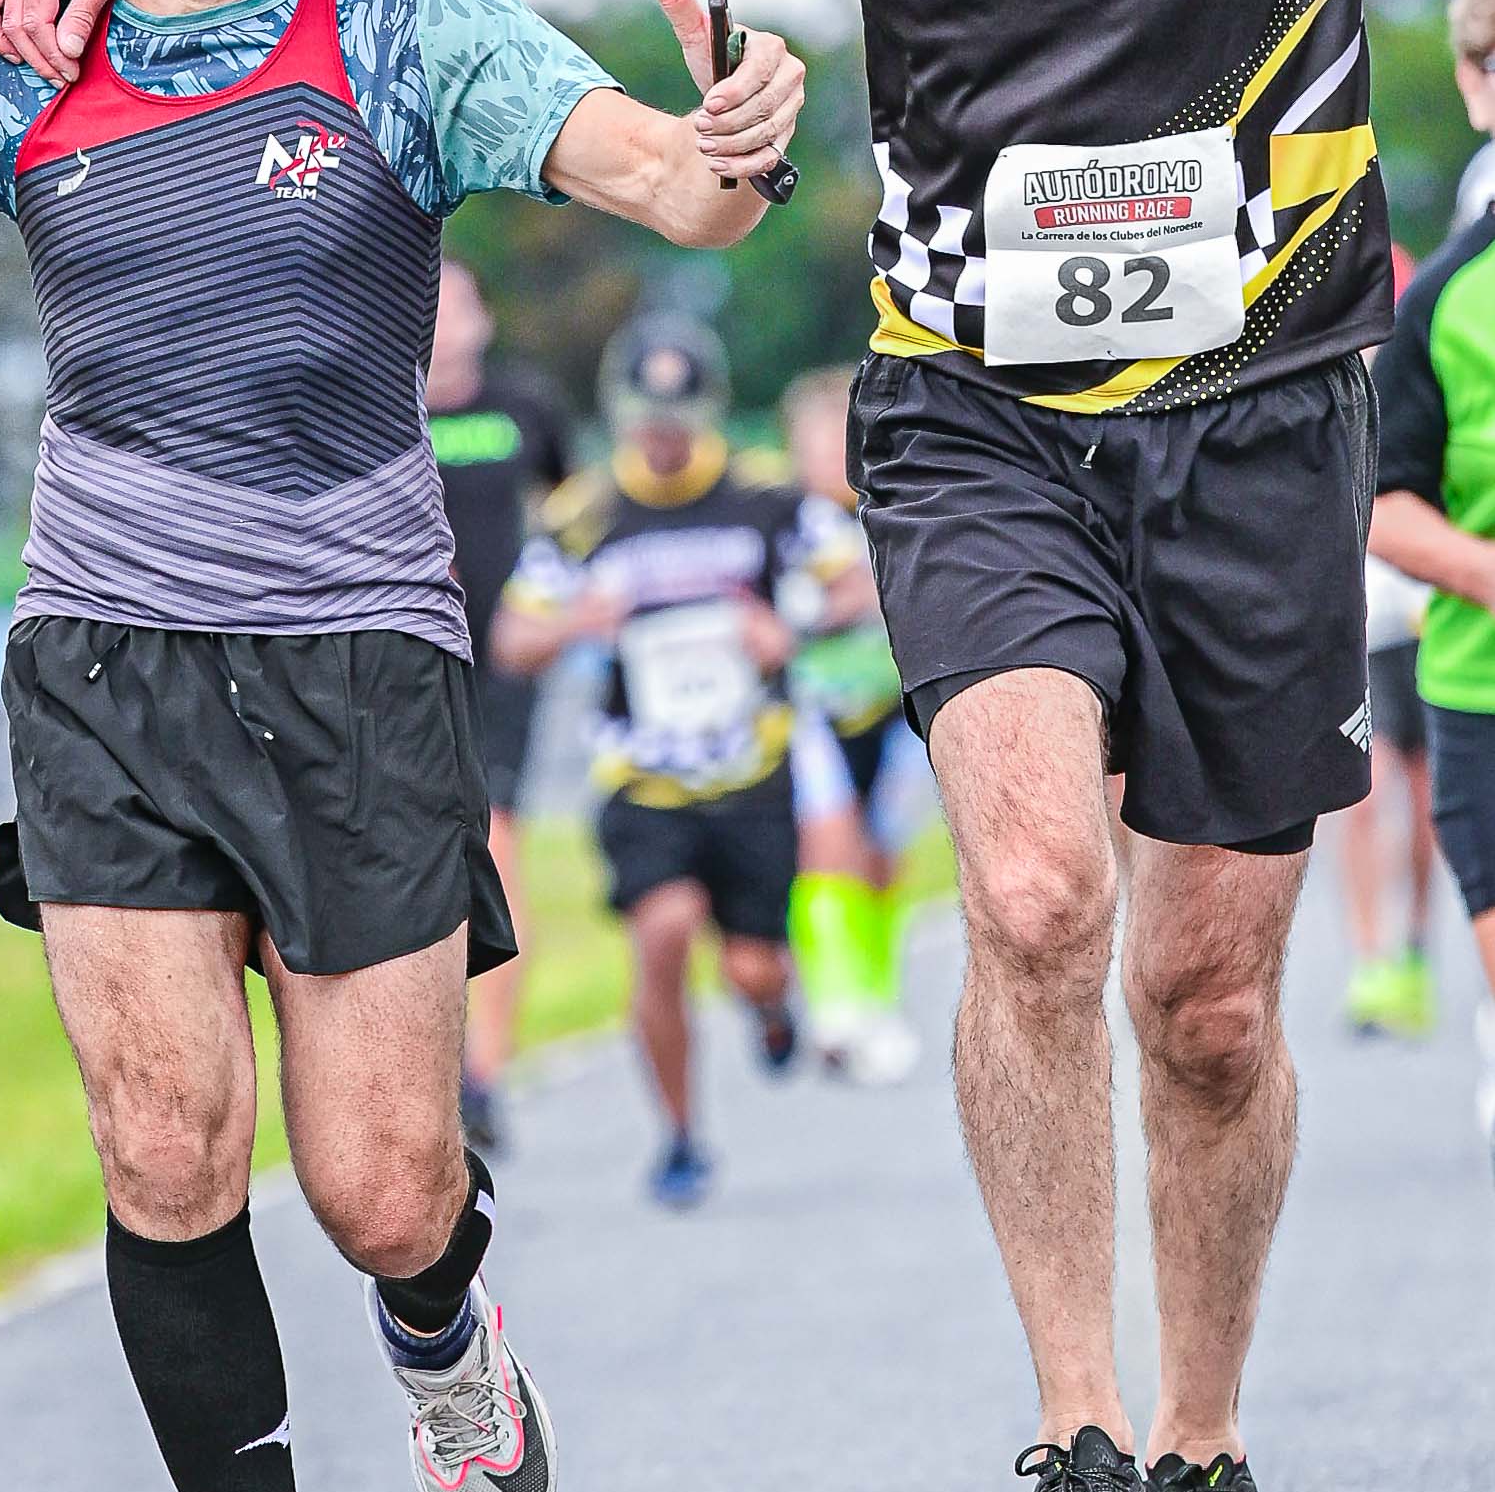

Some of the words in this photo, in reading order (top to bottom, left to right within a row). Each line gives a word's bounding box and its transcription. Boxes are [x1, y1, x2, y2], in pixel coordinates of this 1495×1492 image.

[274, 186, 317, 200] TEAM
[1023, 159, 1202, 205] AUTÓDROMO
[1053, 202, 1129, 226] RUNNING
[1134, 199, 1176, 219] RACE
[1021, 230, 1034, 241] La
[1035, 231, 1075, 241] Carrera
[1076, 230, 1091, 241] de
[1092, 230, 1108, 241] los
[1109, 228, 1145, 242] Clubes
[1146, 225, 1162, 239] del
[1163, 220, 1204, 235] Noroeste
[1055, 255, 1174, 327] 82
